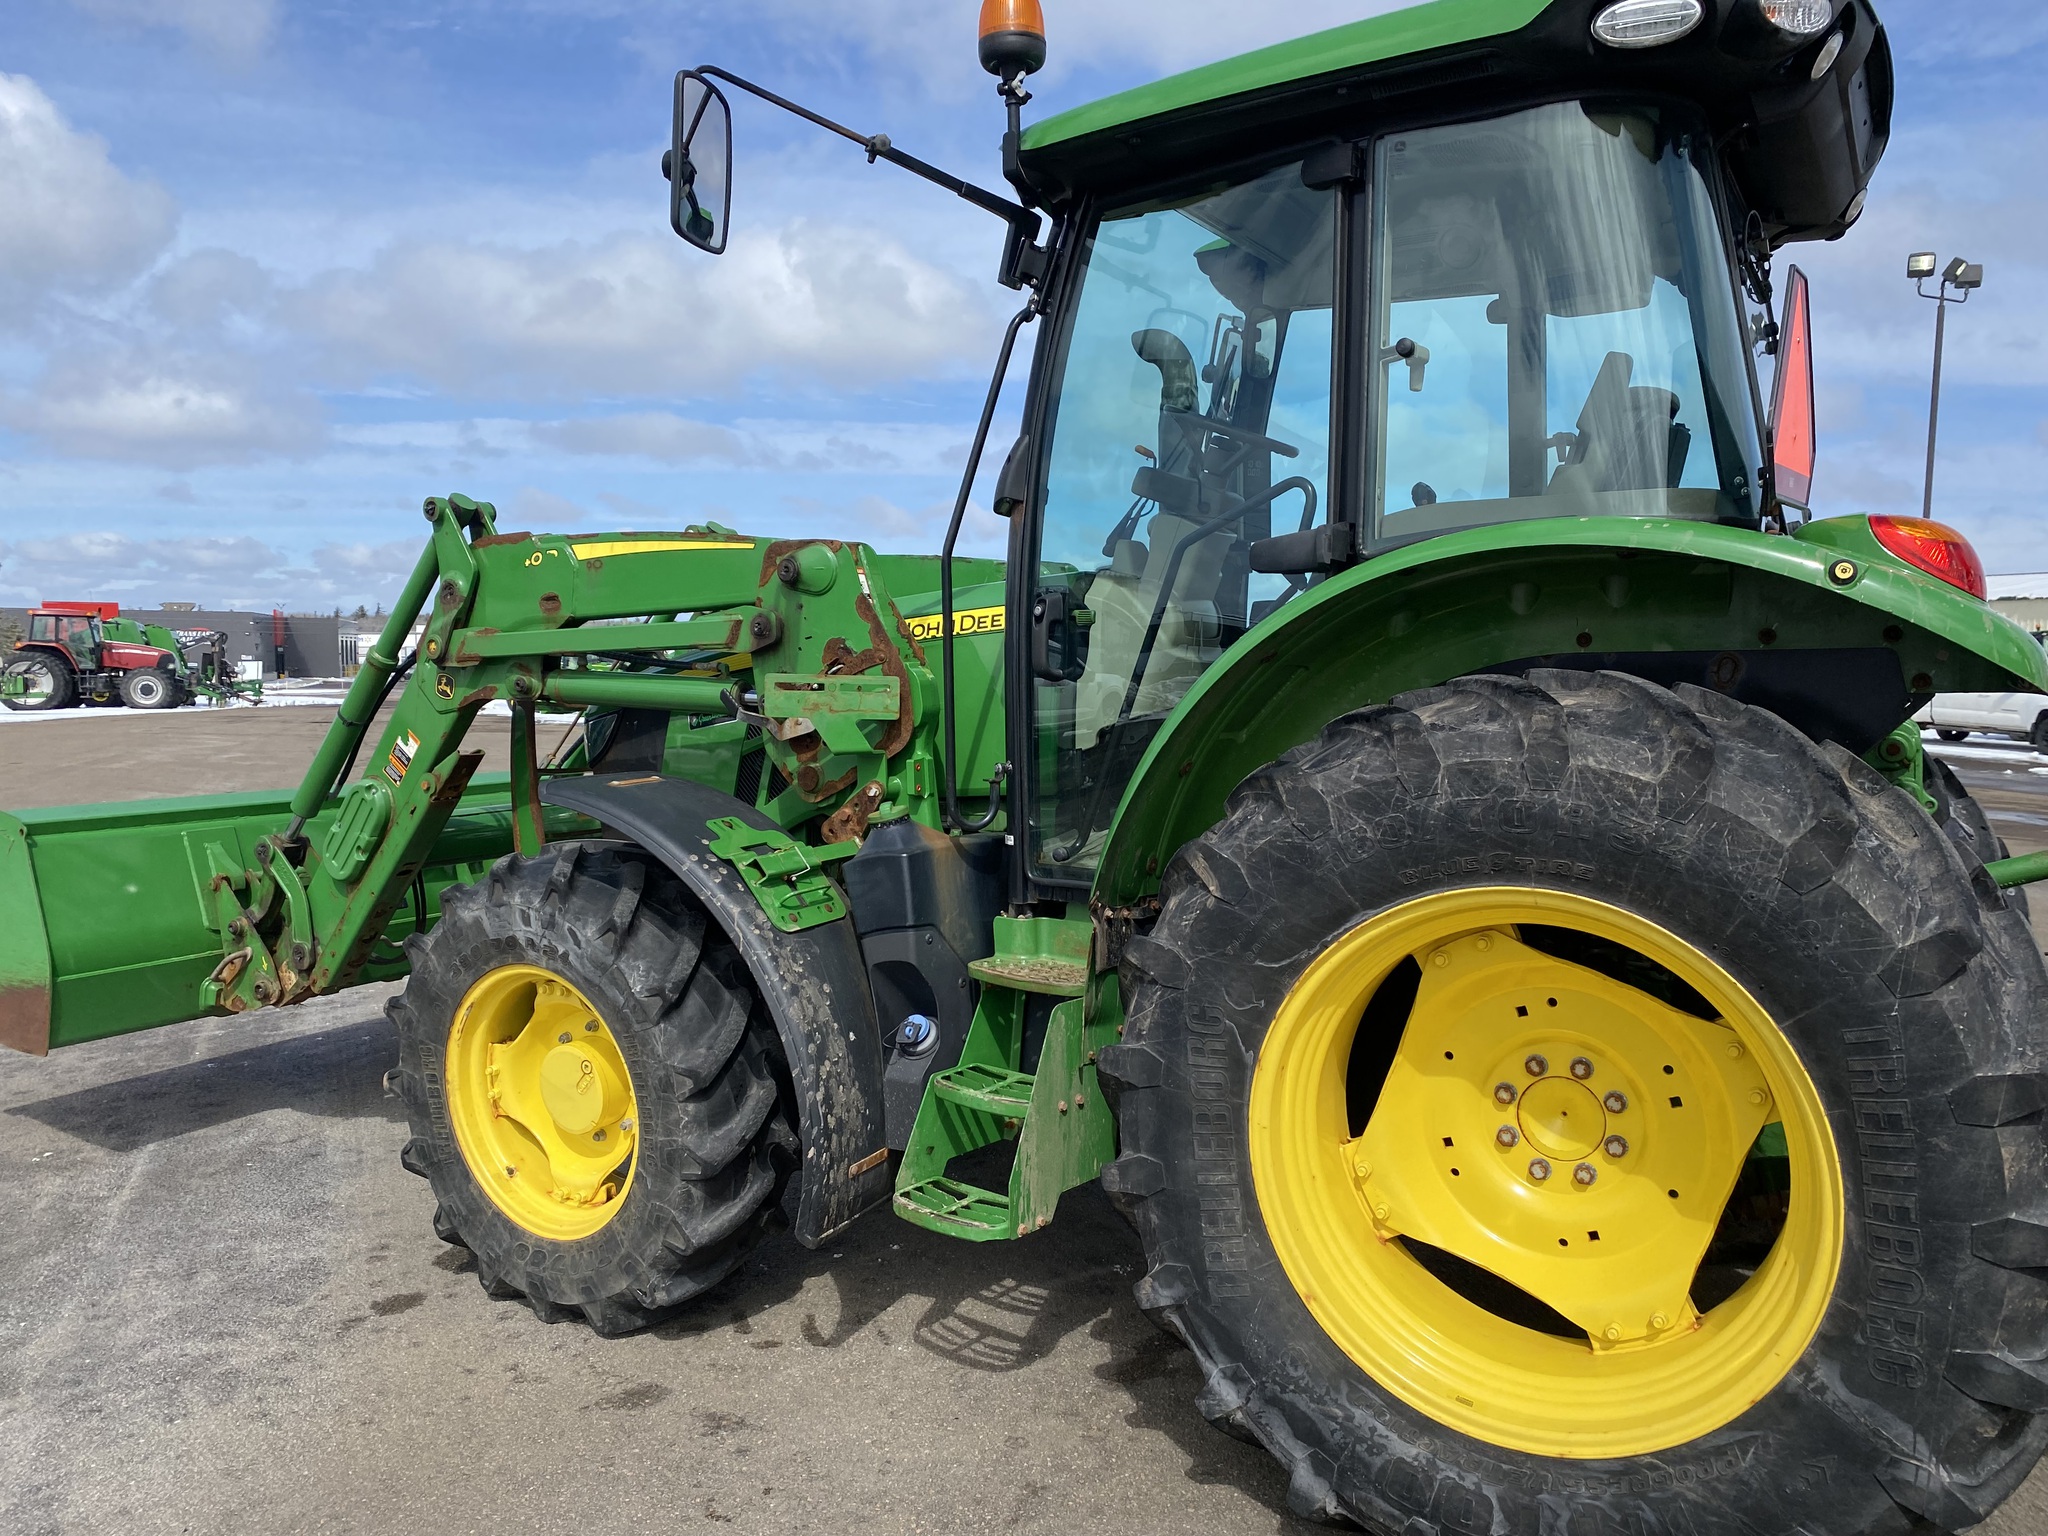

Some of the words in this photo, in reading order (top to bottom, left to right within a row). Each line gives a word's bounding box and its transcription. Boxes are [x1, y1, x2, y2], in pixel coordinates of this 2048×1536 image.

[907, 621, 955, 637] OH
[960, 614, 1003, 631] DEE
[1398, 856, 1480, 885] BLUE
[1514, 856, 1595, 881] TIRE
[419, 1045, 456, 1166] TRELLEBORG
[622, 1033, 658, 1170] TRELLEBORG
[1187, 1003, 1251, 1310] TRELLEBORG
[1842, 1013, 1929, 1390] TRELLEBORG
